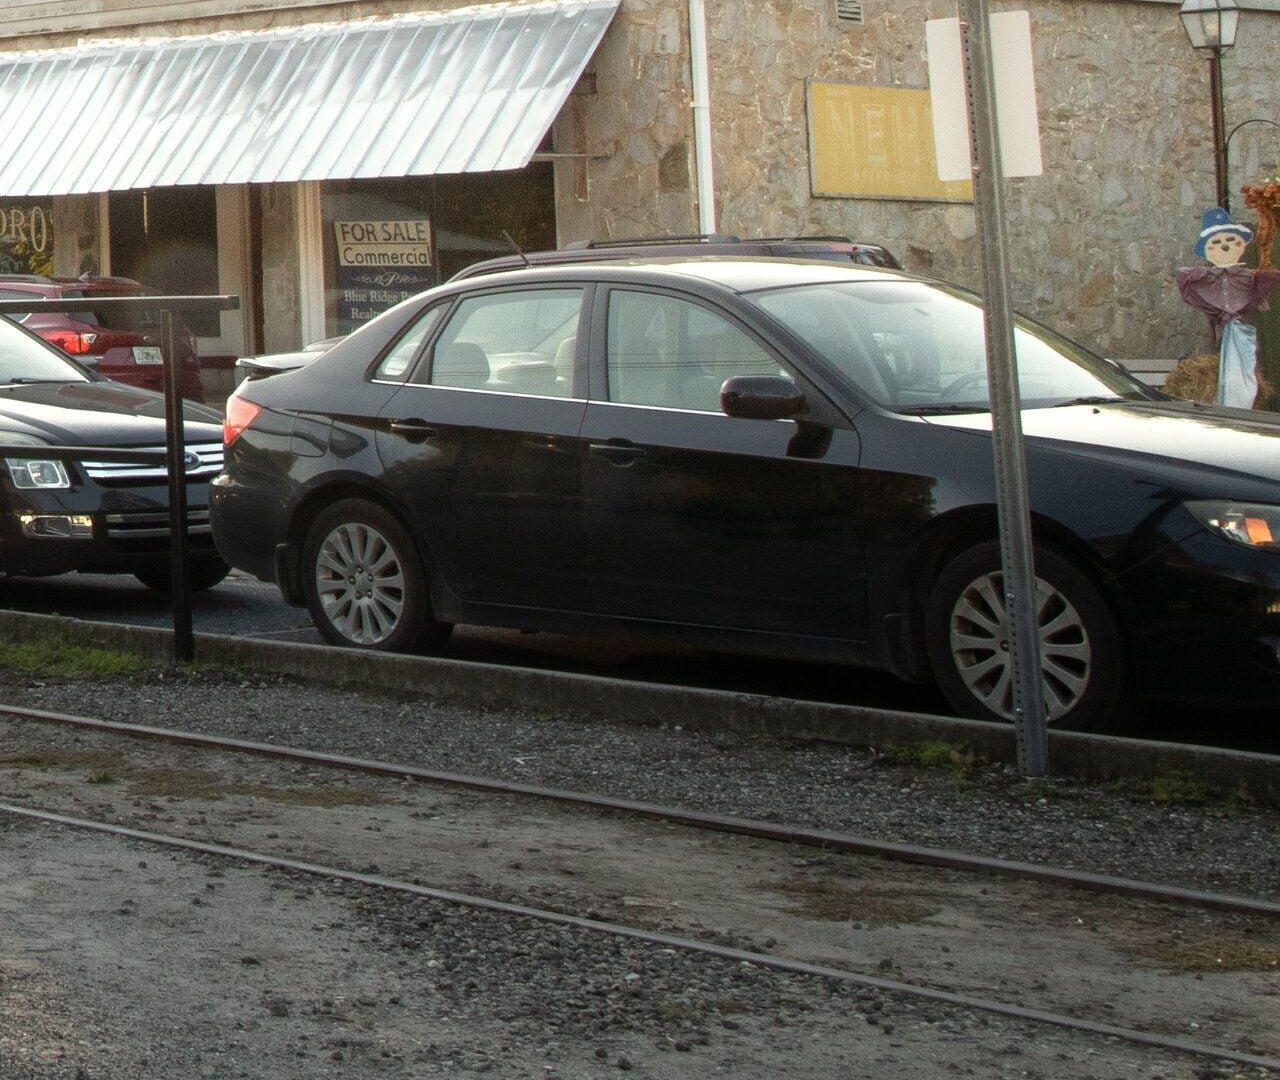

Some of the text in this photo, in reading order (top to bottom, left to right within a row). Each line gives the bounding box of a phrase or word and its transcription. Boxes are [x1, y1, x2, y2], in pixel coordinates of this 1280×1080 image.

[340, 222, 427, 242] FOR SALE
[343, 246, 432, 265] Commercial
[344, 290, 367, 302] Blue
[369, 290, 398, 304] Ridge
